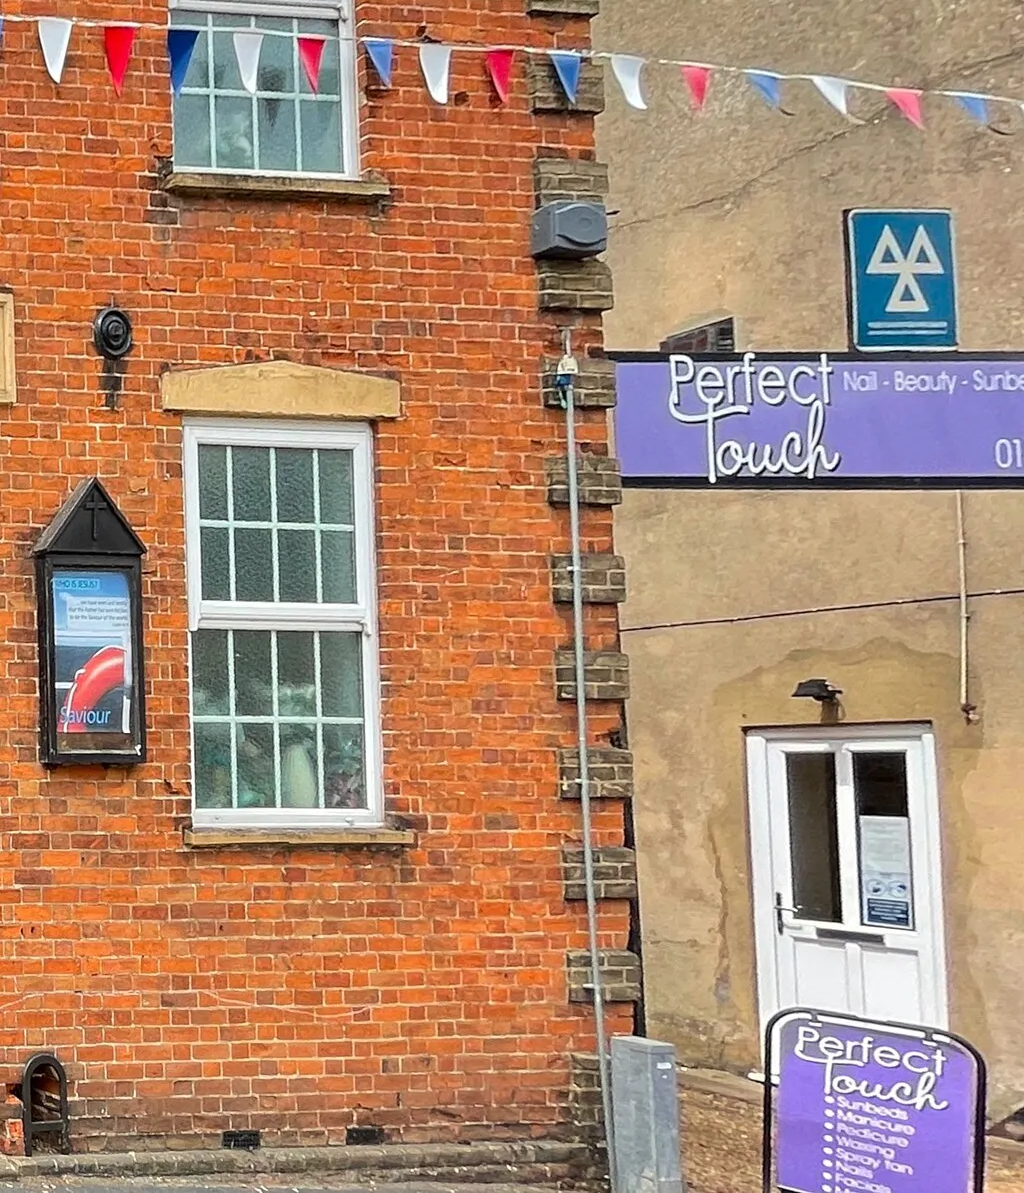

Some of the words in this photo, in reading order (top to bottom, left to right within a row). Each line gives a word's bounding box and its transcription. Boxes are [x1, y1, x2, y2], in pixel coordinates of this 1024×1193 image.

[669, 352, 833, 407] Perfect
[843, 370, 878, 392] Nail
[894, 370, 958, 395] Beauty
[670, 399, 841, 484] Touch
[59, 705, 111, 724] Saviour
[795, 1026, 948, 1076] Perfect
[795, 1050, 948, 1111] Touch
[837, 1095, 909, 1120] Sunbeds
[836, 1109, 916, 1135] Manicure
[836, 1122, 910, 1147] Pedicure
[835, 1147, 882, 1169] Spray
[836, 1135, 895, 1159] Waxing
[835, 1160, 874, 1179] Nails
[835, 1172, 892, 1193] Facials
